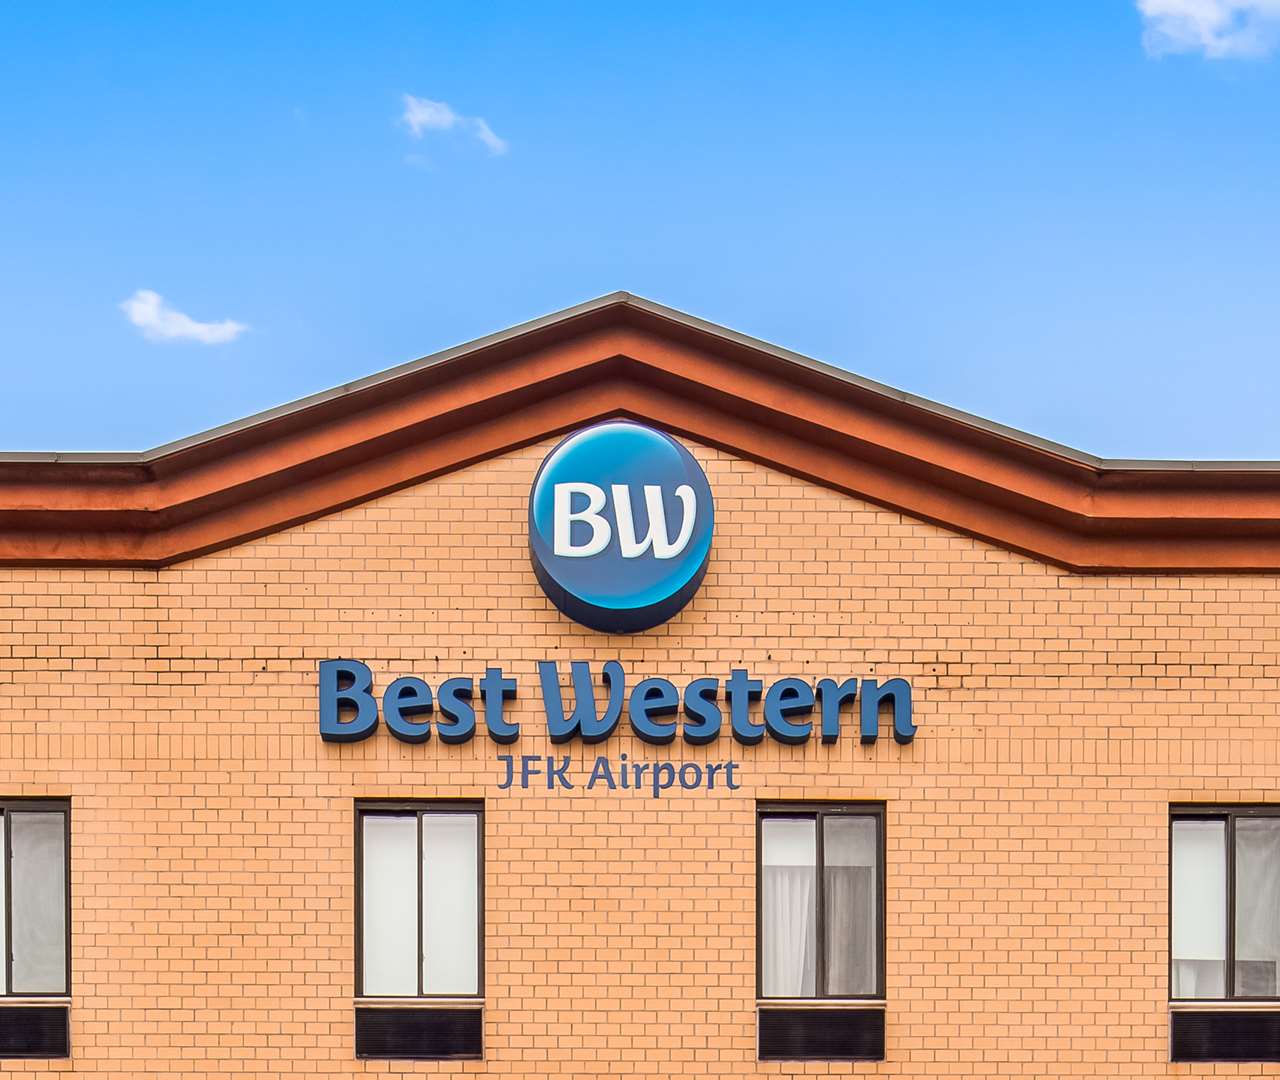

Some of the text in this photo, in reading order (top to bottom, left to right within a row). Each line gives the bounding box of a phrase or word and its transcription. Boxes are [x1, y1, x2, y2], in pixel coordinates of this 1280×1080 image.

[552, 481, 697, 560] BW
[319, 659, 918, 746] Best Western
[496, 753, 741, 798] JFK Airport
